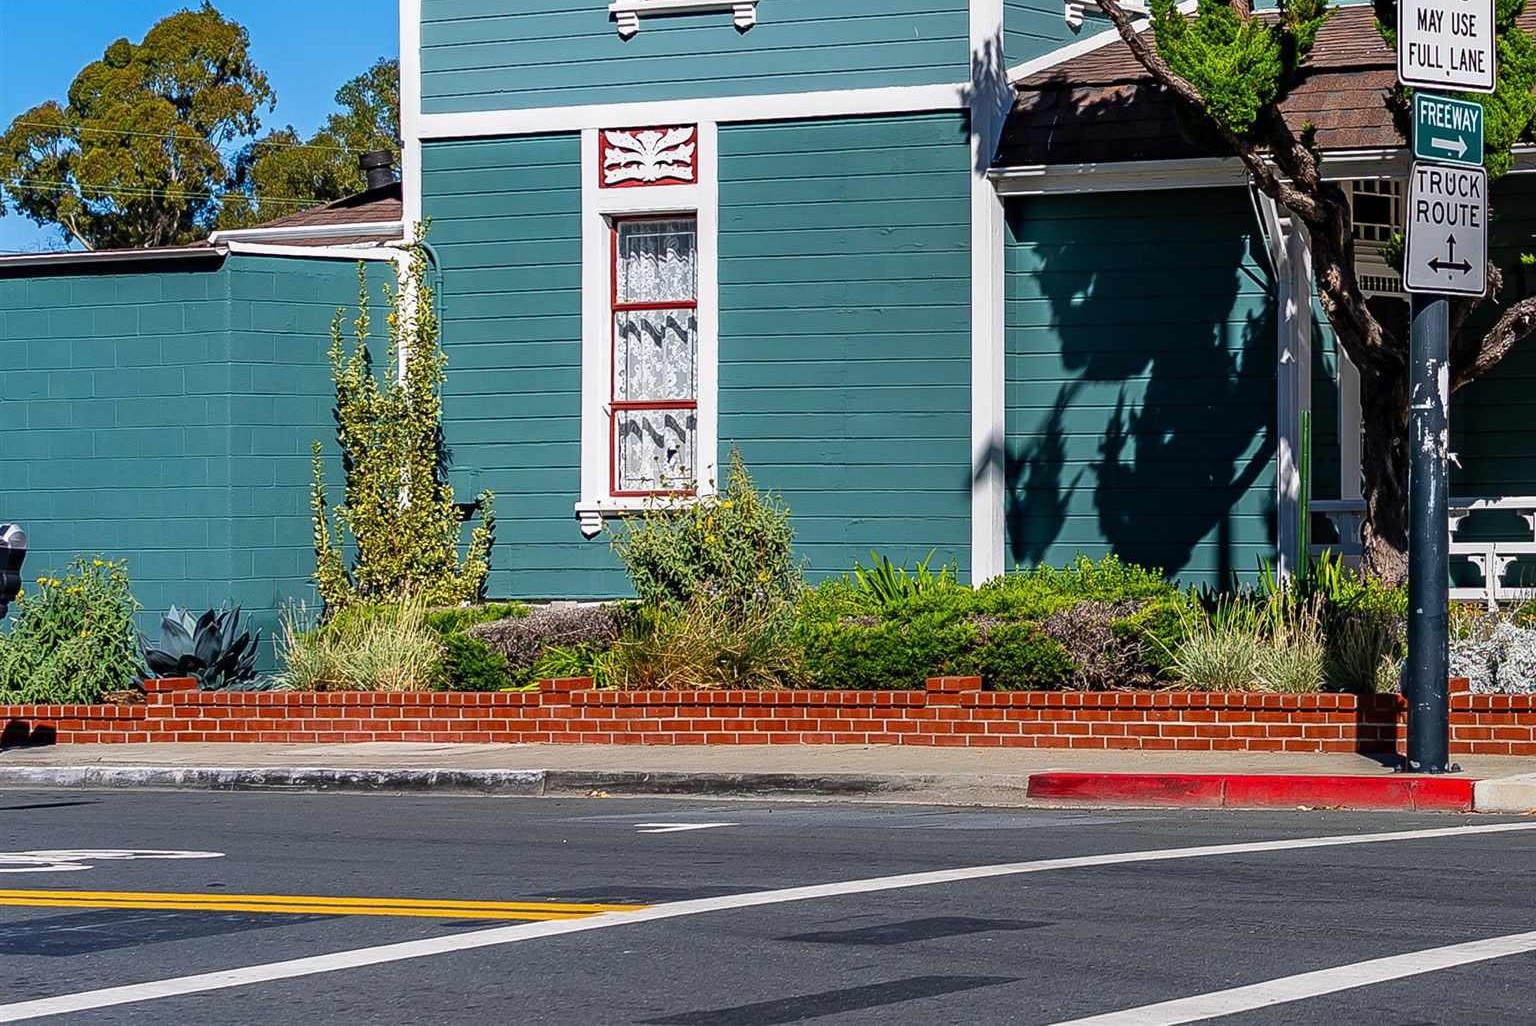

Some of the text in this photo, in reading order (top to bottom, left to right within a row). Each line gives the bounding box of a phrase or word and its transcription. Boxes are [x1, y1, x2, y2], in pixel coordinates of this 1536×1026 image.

[1417, 8, 1477, 37] MAY USE
[1409, 43, 1485, 73] FULL LANE
[1420, 101, 1479, 133] FREEWAY
[1417, 170, 1480, 198] TRUCK
[1417, 200, 1480, 228] ROUTE
